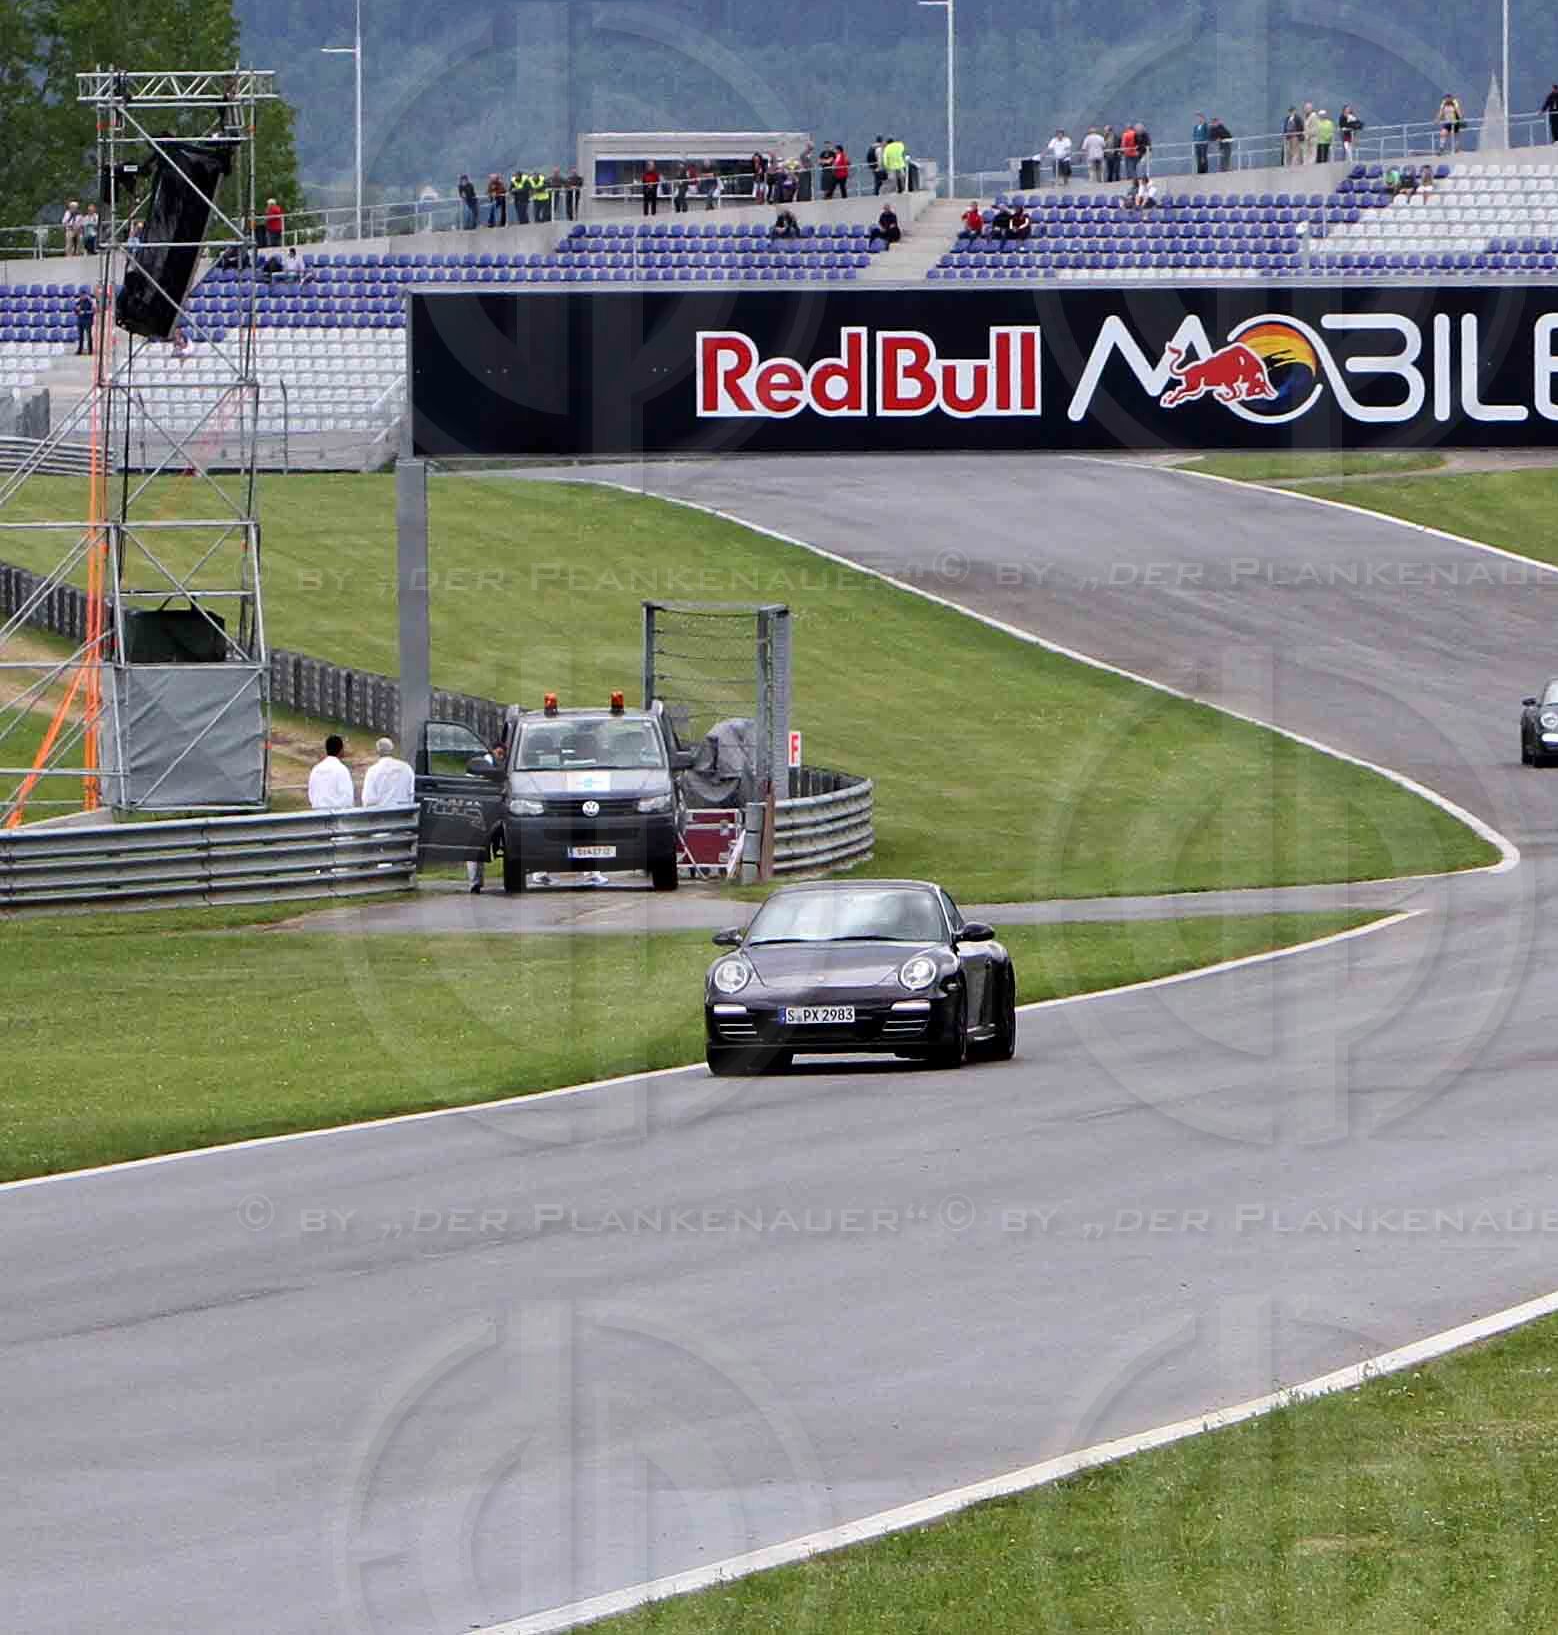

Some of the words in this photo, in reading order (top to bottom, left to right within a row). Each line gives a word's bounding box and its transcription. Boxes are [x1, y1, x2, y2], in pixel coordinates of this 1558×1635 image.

[696, 326, 868, 418] Red
[876, 325, 1041, 418] Bull
[787, 1009, 795, 1022] S
[803, 1009, 820, 1022] PX
[822, 1008, 853, 1021] 2983
